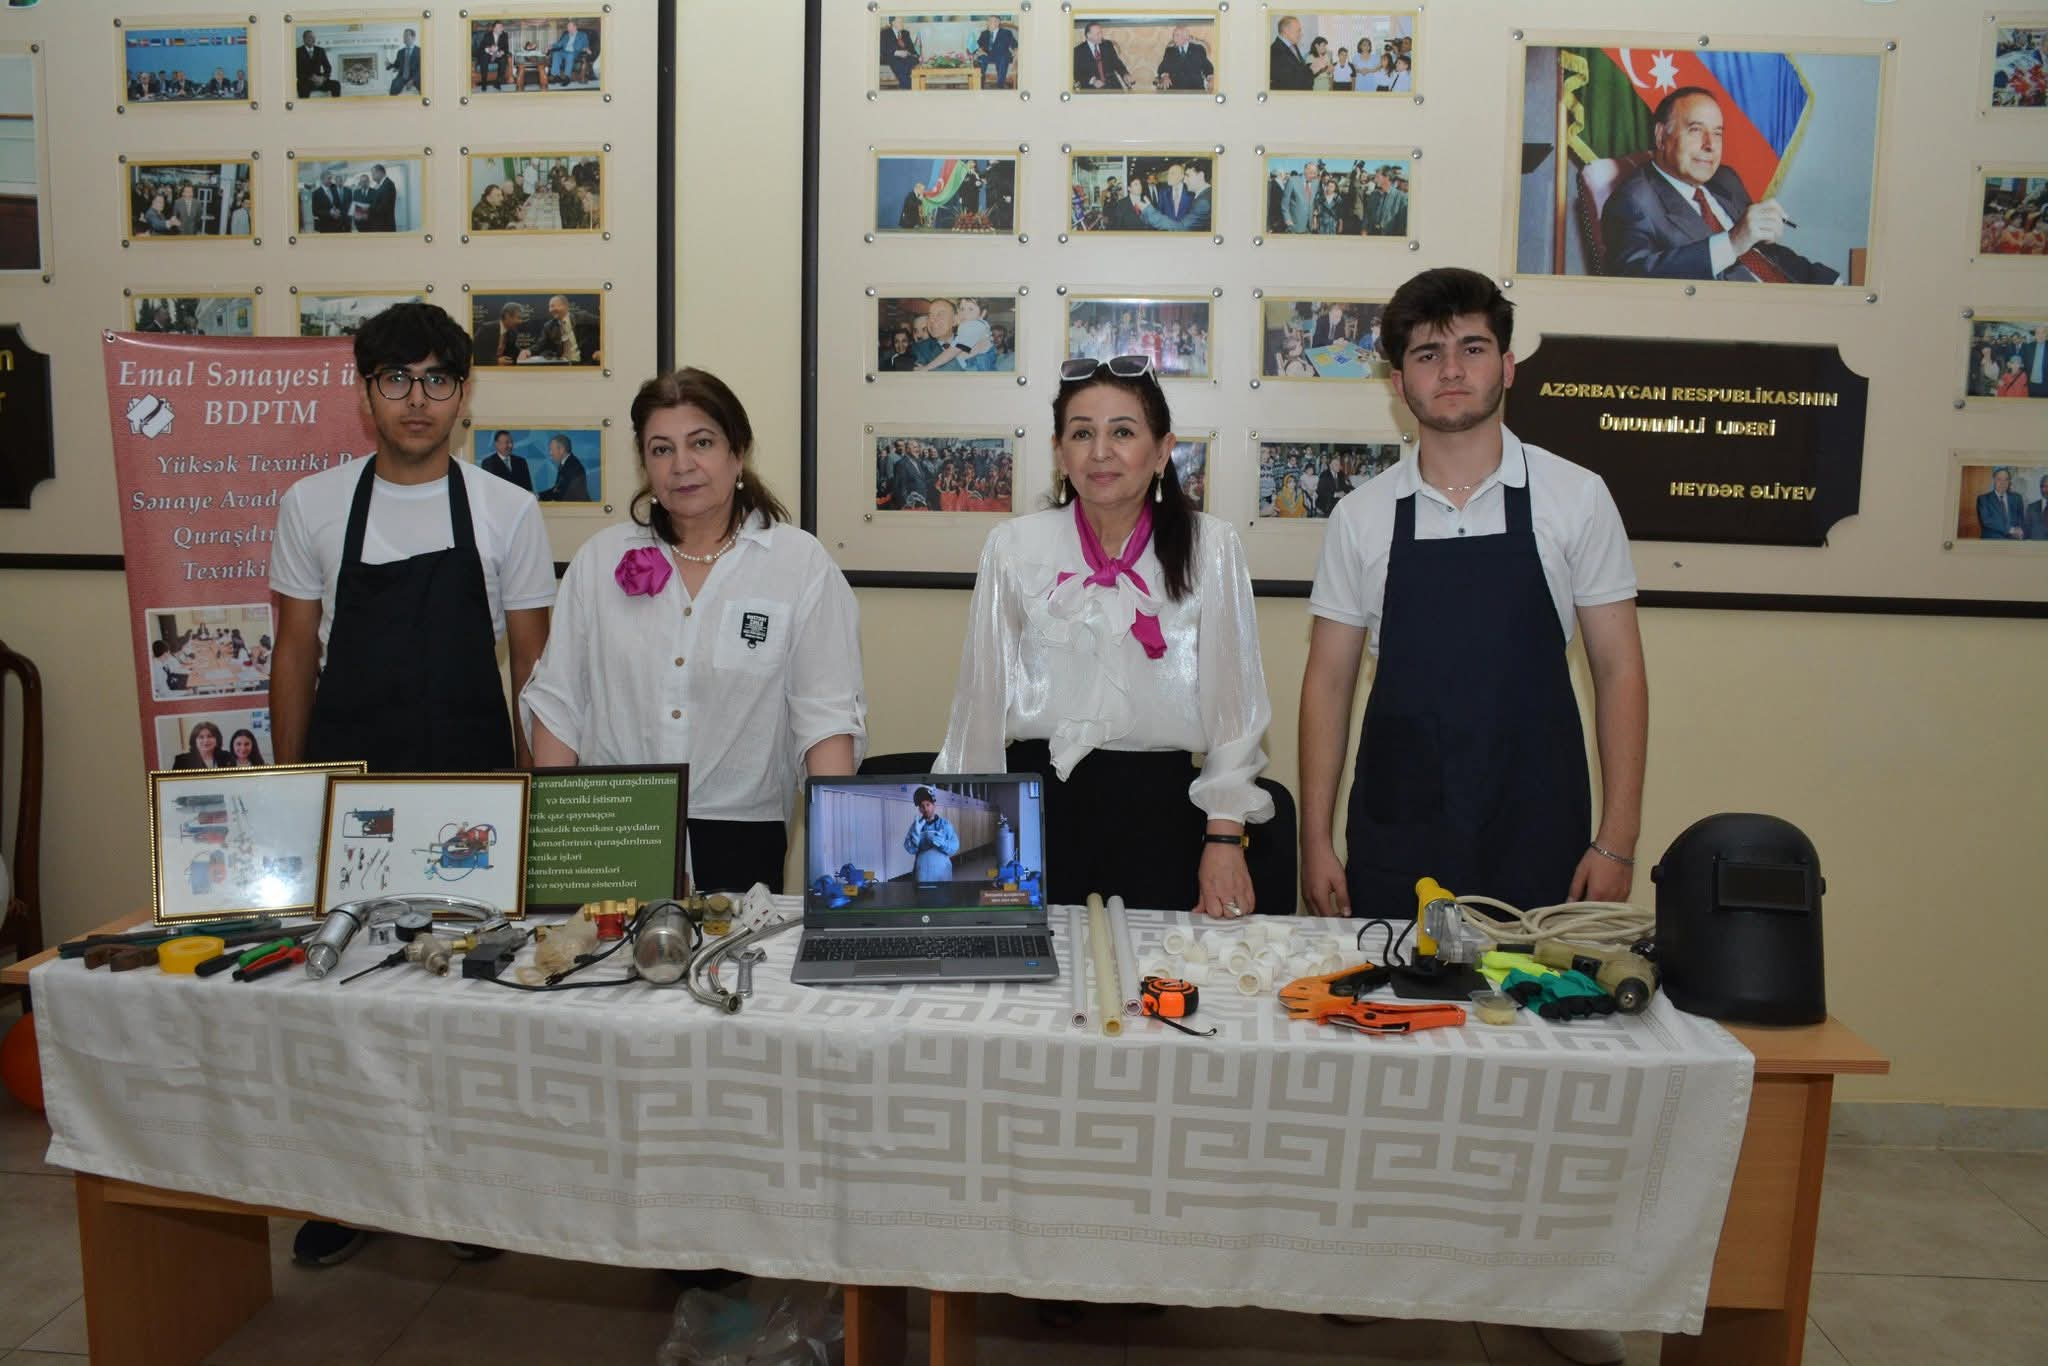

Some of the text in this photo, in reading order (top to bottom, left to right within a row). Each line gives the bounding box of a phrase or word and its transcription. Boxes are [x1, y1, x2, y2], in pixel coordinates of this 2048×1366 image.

[119, 360, 195, 386] Emal
[207, 362, 330, 394] Sənayesi
[1540, 382, 1839, 407] AZƏRBAYCAN RESPUBLİKASININ
[204, 399, 319, 425] BDPTM
[157, 455, 240, 474] Yüksək
[248, 452, 329, 473] Texniki
[1670, 481, 1816, 501] HEYDƏR ƏLİYEV
[132, 490, 213, 516] Sənaye
[183, 559, 266, 580] Texniki
[559, 795, 591, 805] texniki
